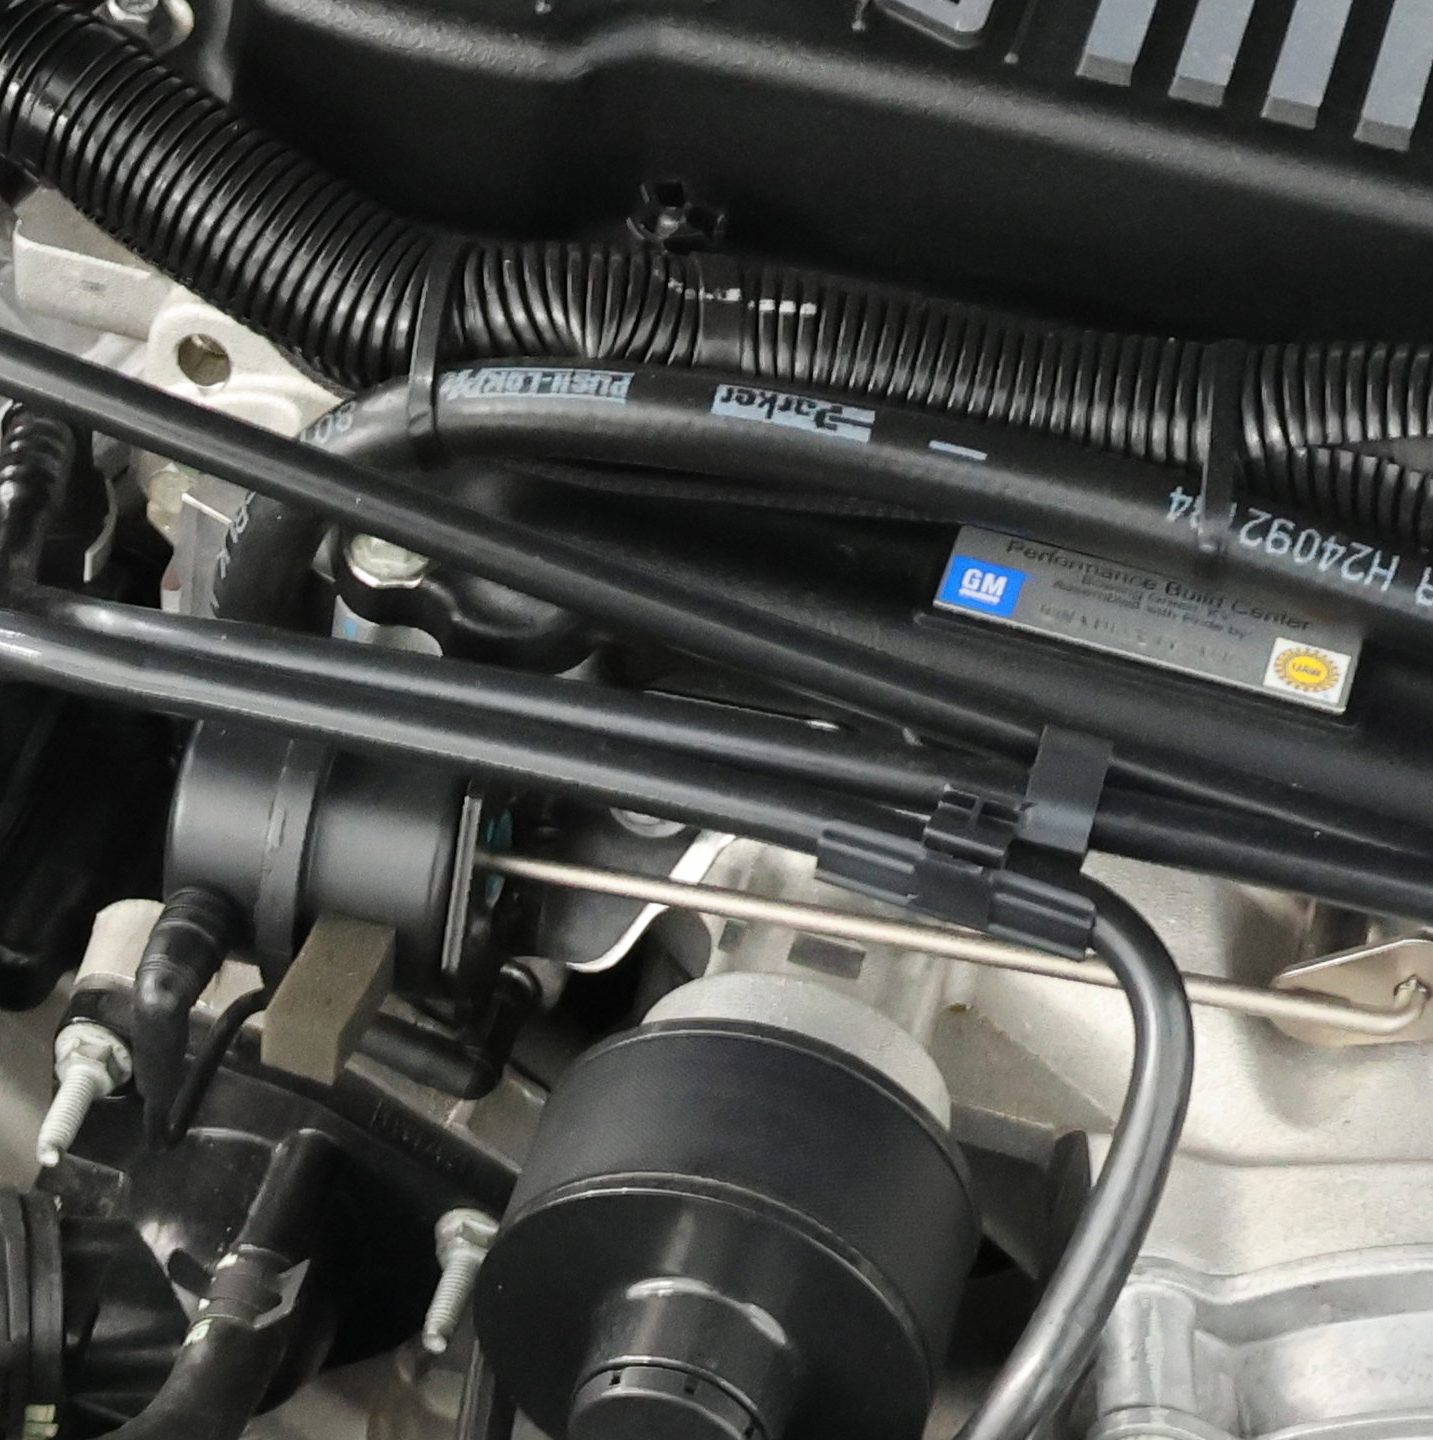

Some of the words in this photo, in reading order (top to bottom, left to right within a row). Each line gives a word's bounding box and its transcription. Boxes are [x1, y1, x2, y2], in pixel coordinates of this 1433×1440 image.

[717, 385, 867, 439] Parker
[962, 568, 1008, 598] GM
[1005, 540, 1157, 592] Performance
[1164, 581, 1225, 610] Build
[1231, 600, 1314, 632] Center
